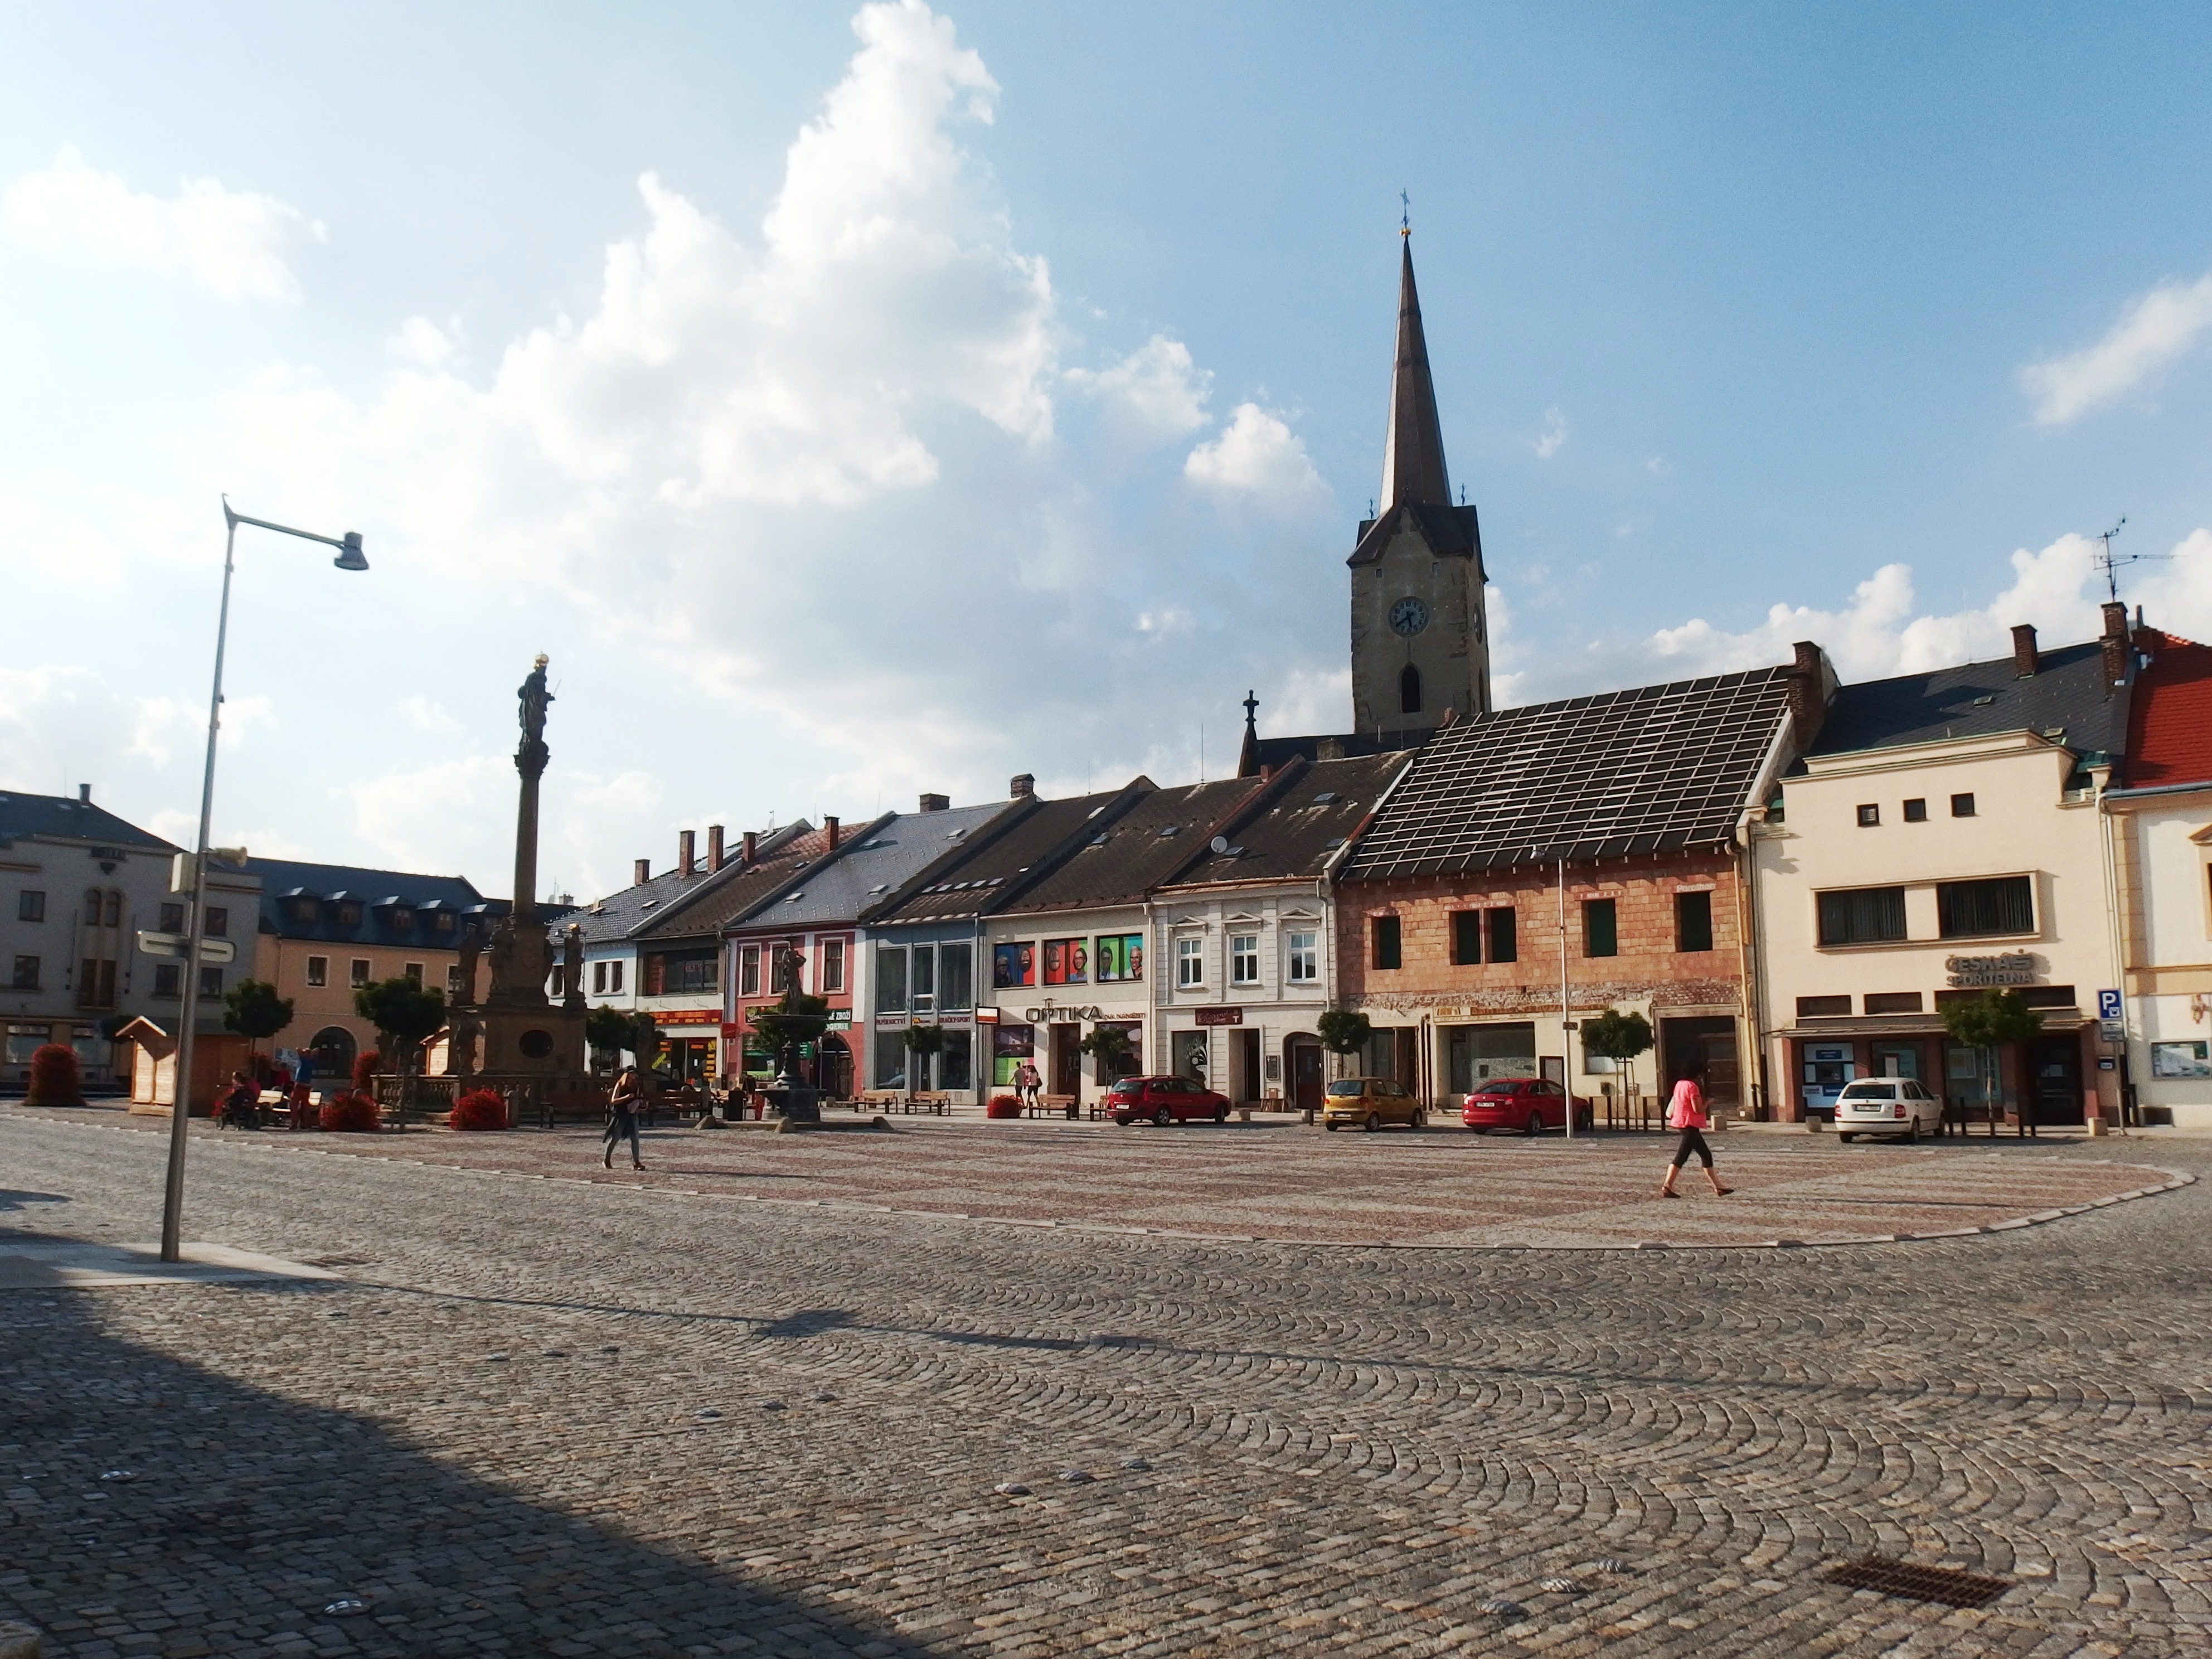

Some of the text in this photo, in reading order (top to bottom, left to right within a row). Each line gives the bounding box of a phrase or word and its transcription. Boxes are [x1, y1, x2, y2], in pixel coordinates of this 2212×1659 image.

[1945, 952, 2011, 973] ČESKÁ
[2102, 992, 2117, 1010] P
[1026, 1006, 1103, 1022] OPTIKA
